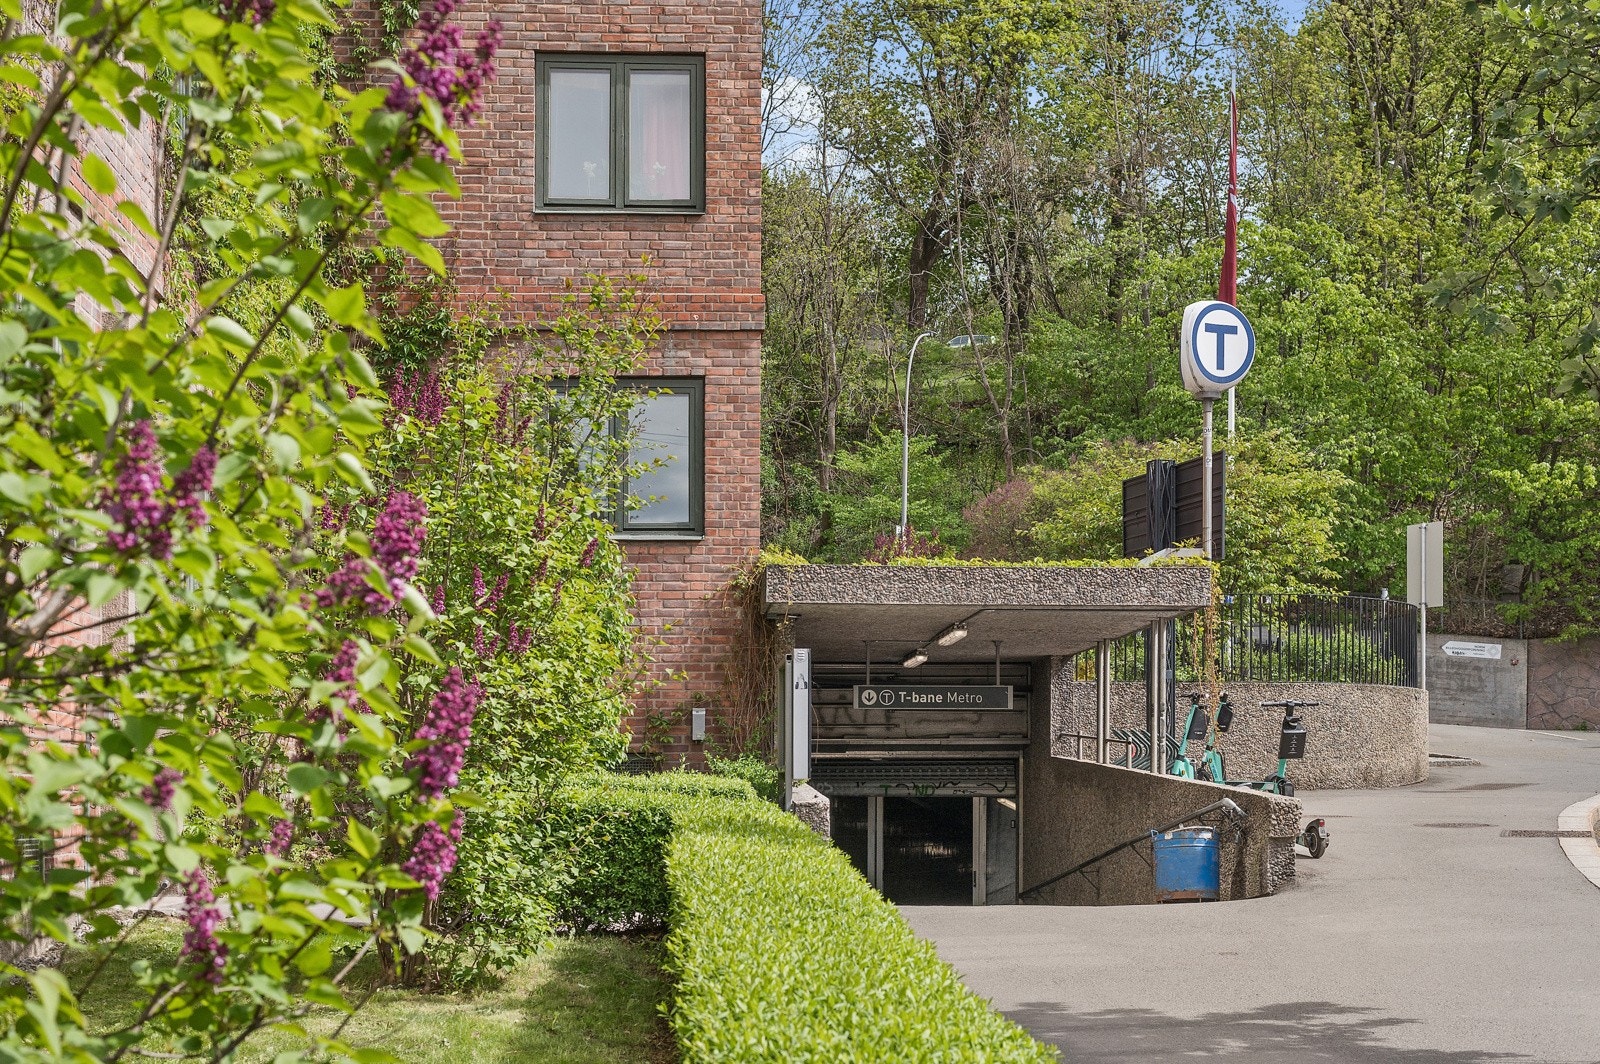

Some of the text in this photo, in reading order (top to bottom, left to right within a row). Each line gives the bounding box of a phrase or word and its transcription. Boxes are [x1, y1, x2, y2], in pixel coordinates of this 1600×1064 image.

[1205, 323, 1238, 371] T
[899, 692, 943, 703] T-bane
[947, 692, 983, 703] Metro
